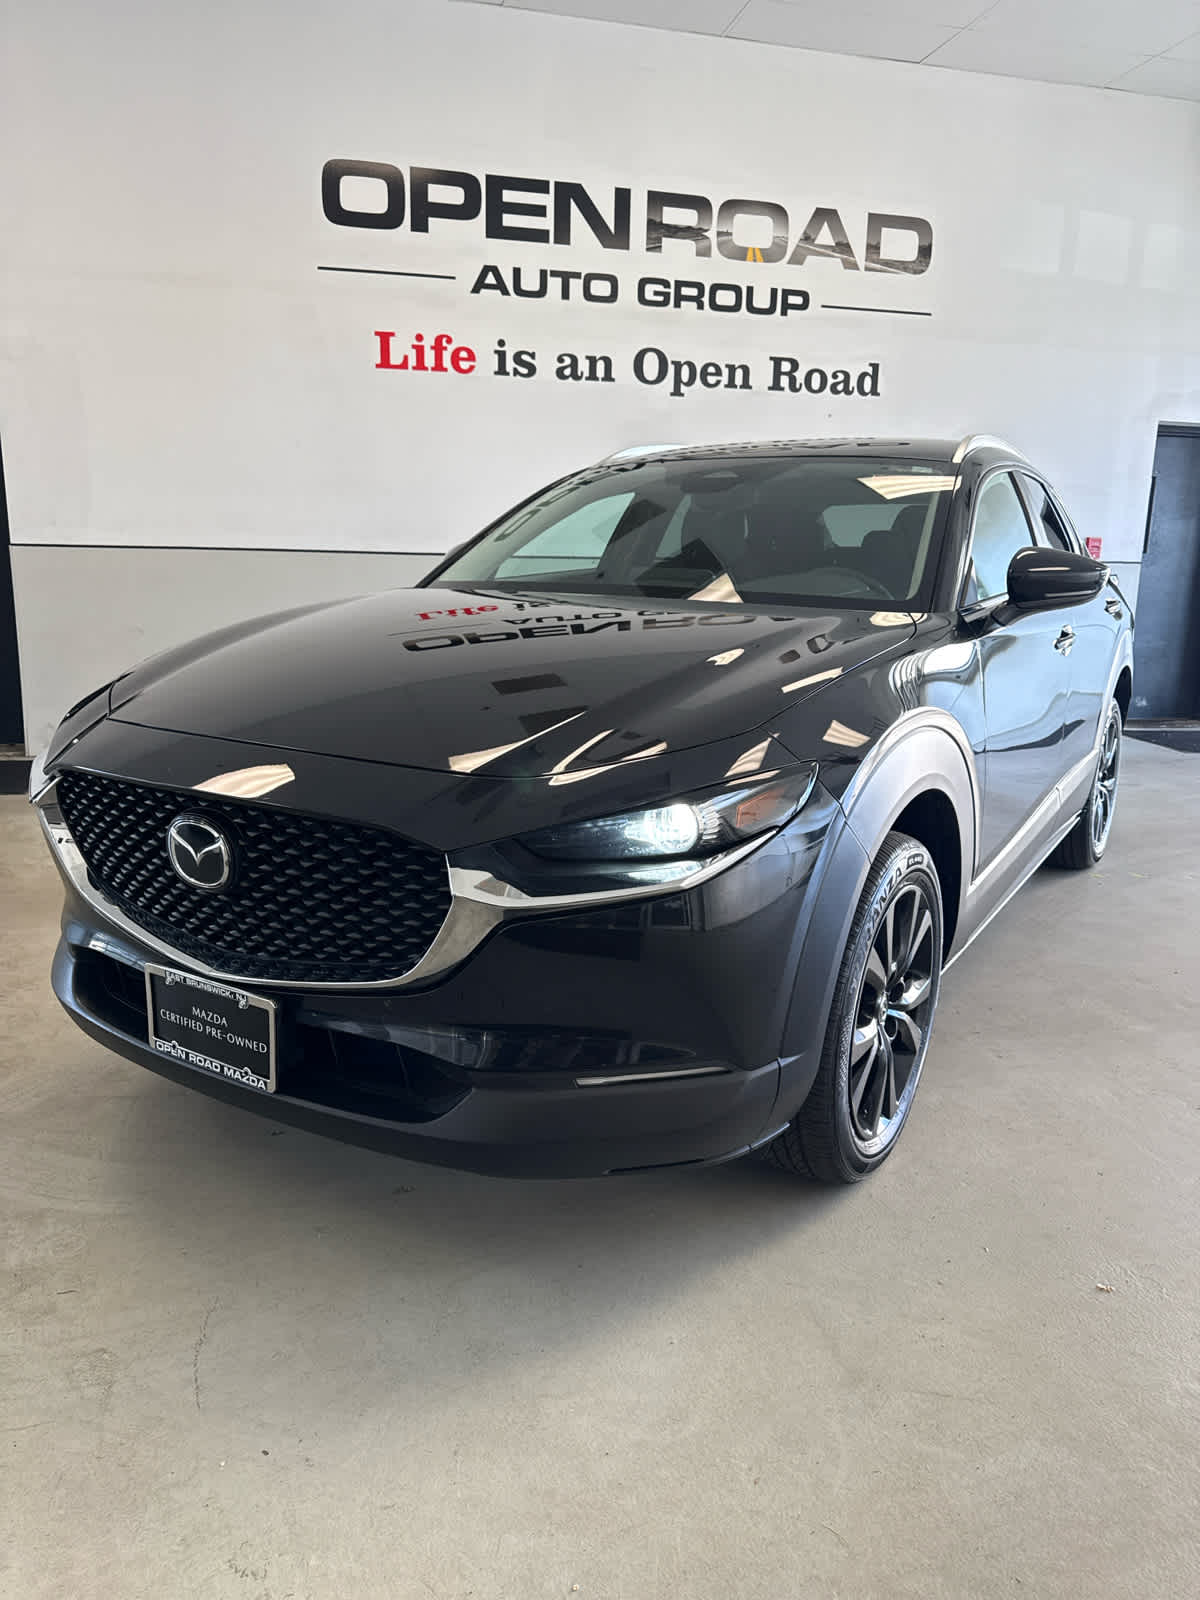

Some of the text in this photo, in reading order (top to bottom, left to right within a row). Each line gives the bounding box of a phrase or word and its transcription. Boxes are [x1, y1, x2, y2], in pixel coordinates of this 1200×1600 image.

[321, 158, 934, 276] OPEN ROAD
[470, 264, 811, 317] AUTO GROUP
[374, 330, 881, 397] Life is an Open Road
[165, 971, 184, 985] EAST
[235, 993, 247, 1002] NJ
[160, 1008, 268, 1053] CERTIFIED PRE-OWNED
[192, 1006, 228, 1027] MAZDA
[156, 1041, 266, 1090] OPEN ROAD MAZDA
